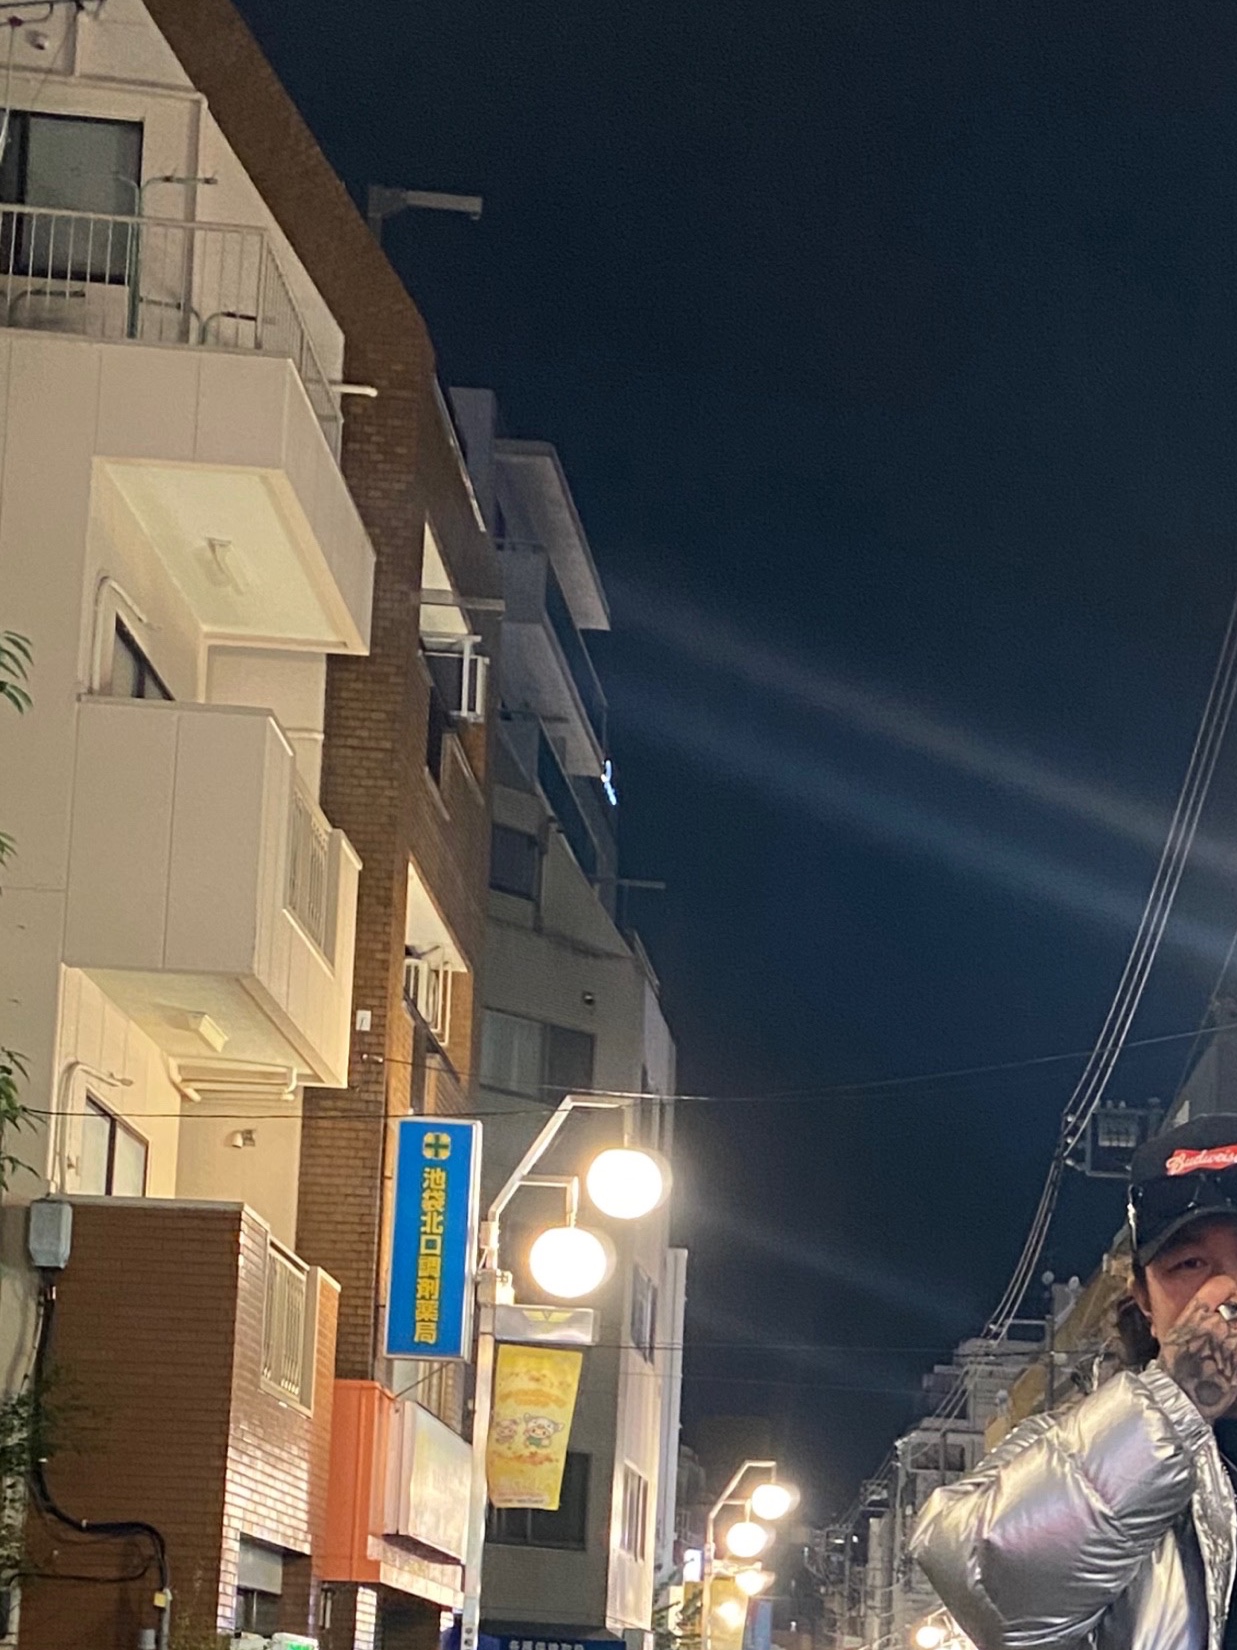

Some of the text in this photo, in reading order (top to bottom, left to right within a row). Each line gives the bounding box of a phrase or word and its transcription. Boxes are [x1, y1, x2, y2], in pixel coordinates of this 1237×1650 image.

[413, 1167, 447, 1344] 池袋北口調剤薬局
